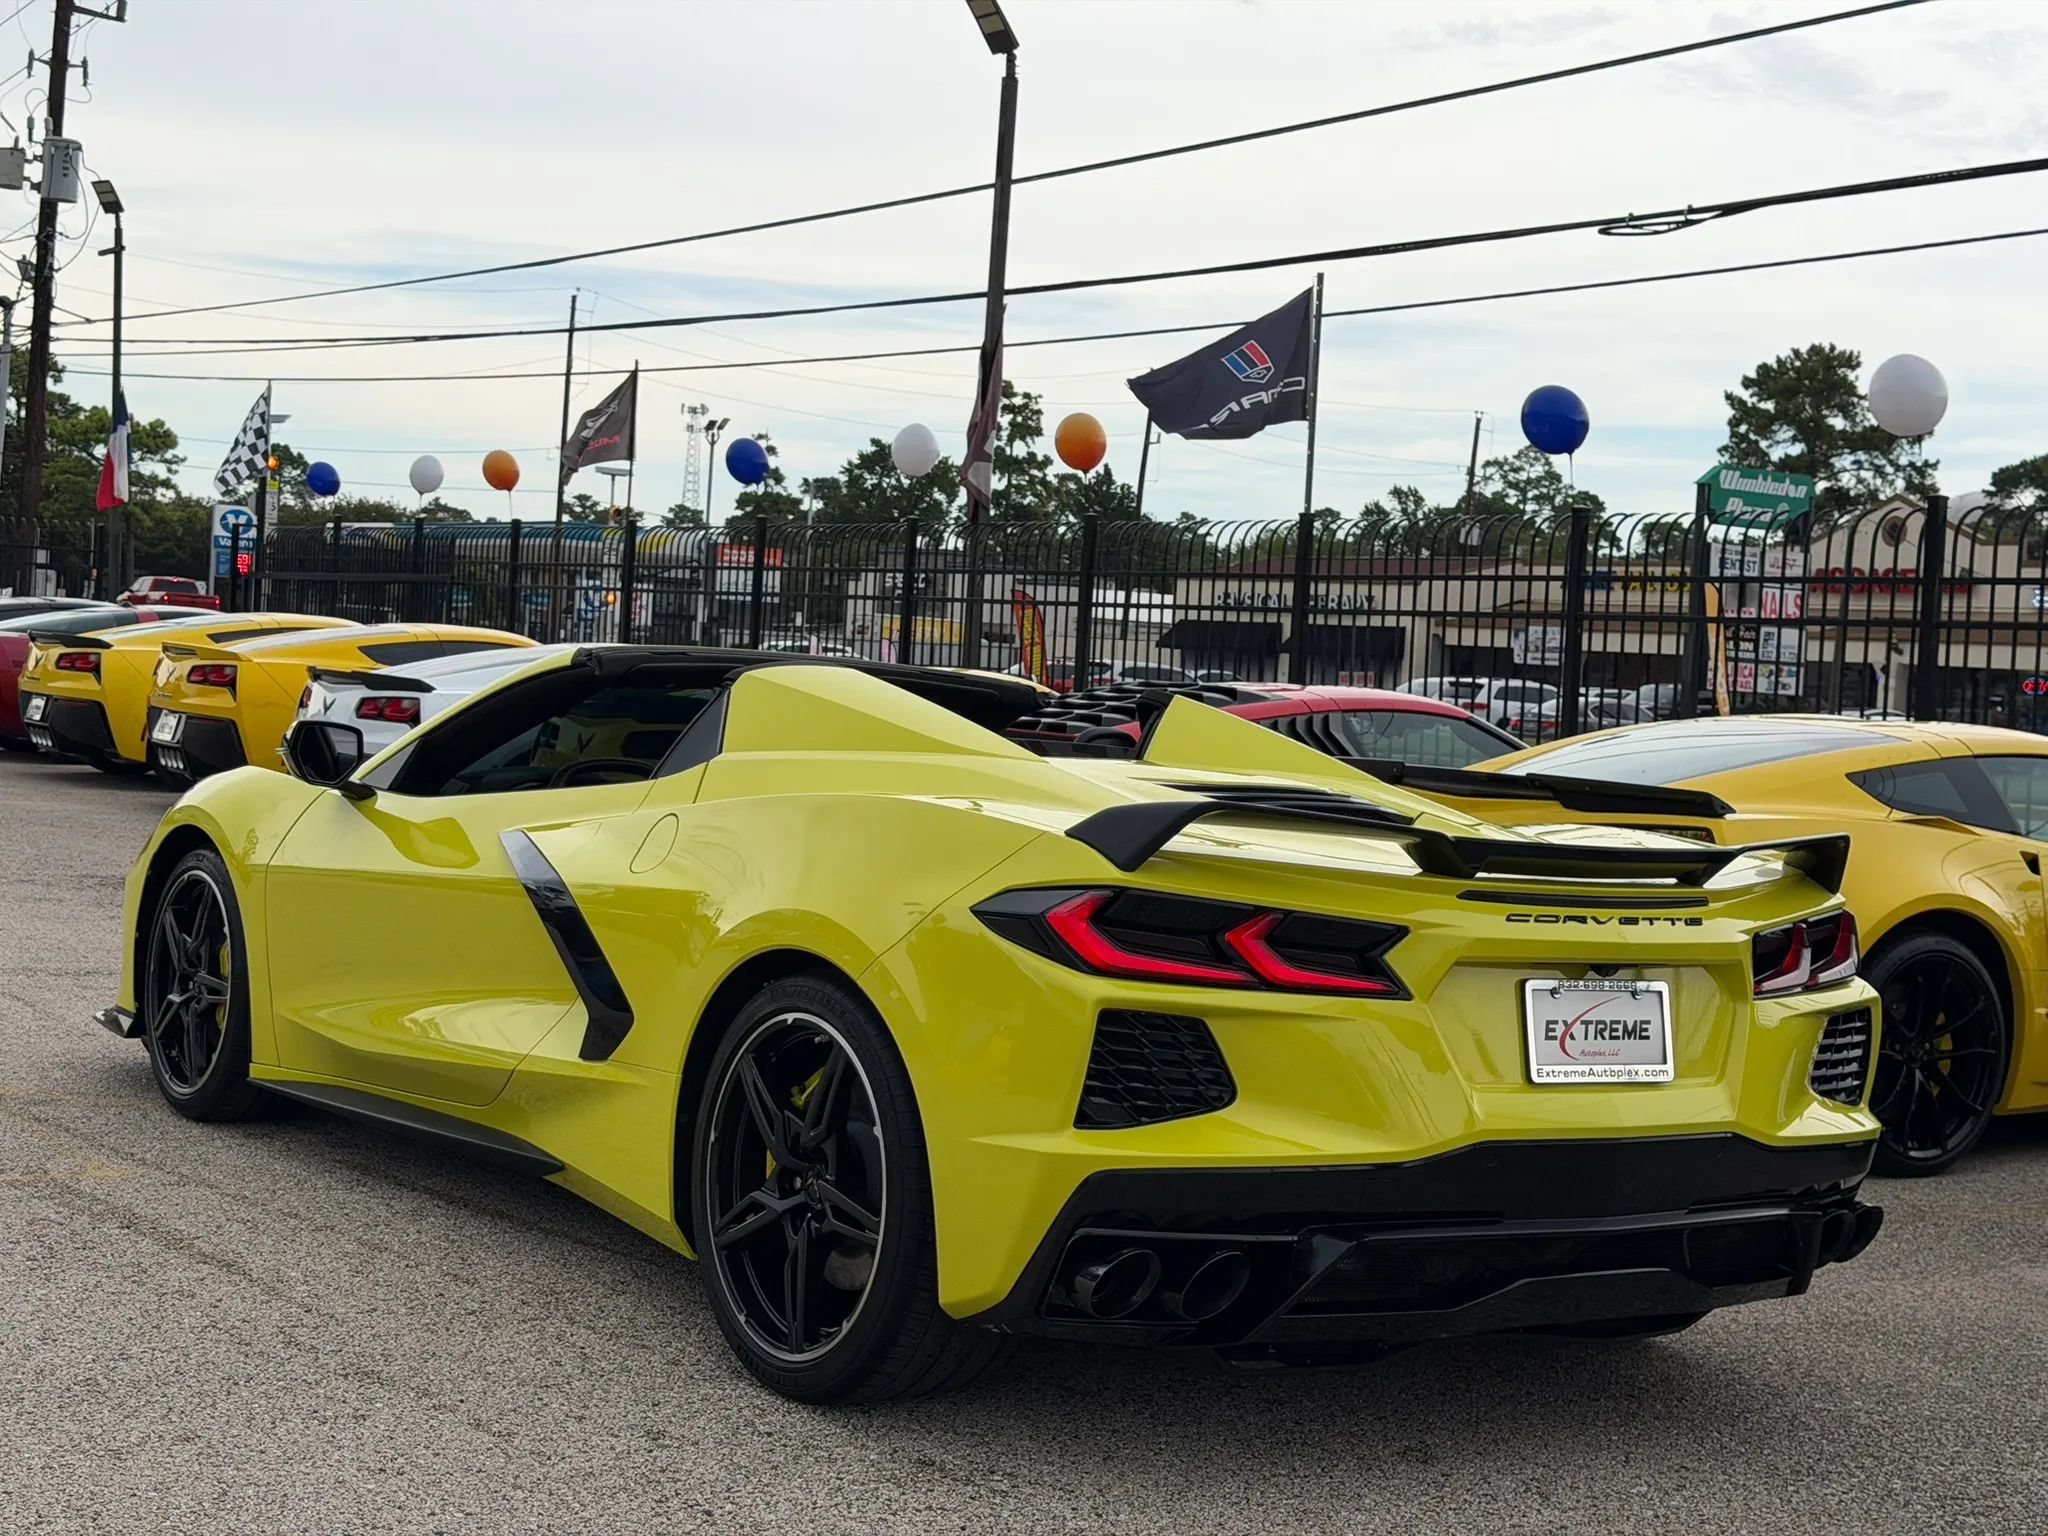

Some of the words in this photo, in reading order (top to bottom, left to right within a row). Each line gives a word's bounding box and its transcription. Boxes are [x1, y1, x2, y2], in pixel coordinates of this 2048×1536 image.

[1720, 469, 1808, 498] Wimbledon
[1725, 497, 1774, 522] Plaza
[1719, 557, 1758, 573] ENST
[1760, 590, 1802, 620] NALS
[1505, 913, 1703, 926] CORVETTE
[1544, 1019, 1651, 1041] EXTREME
[1535, 1067, 1669, 1080] ExtremeAutoplex.com
